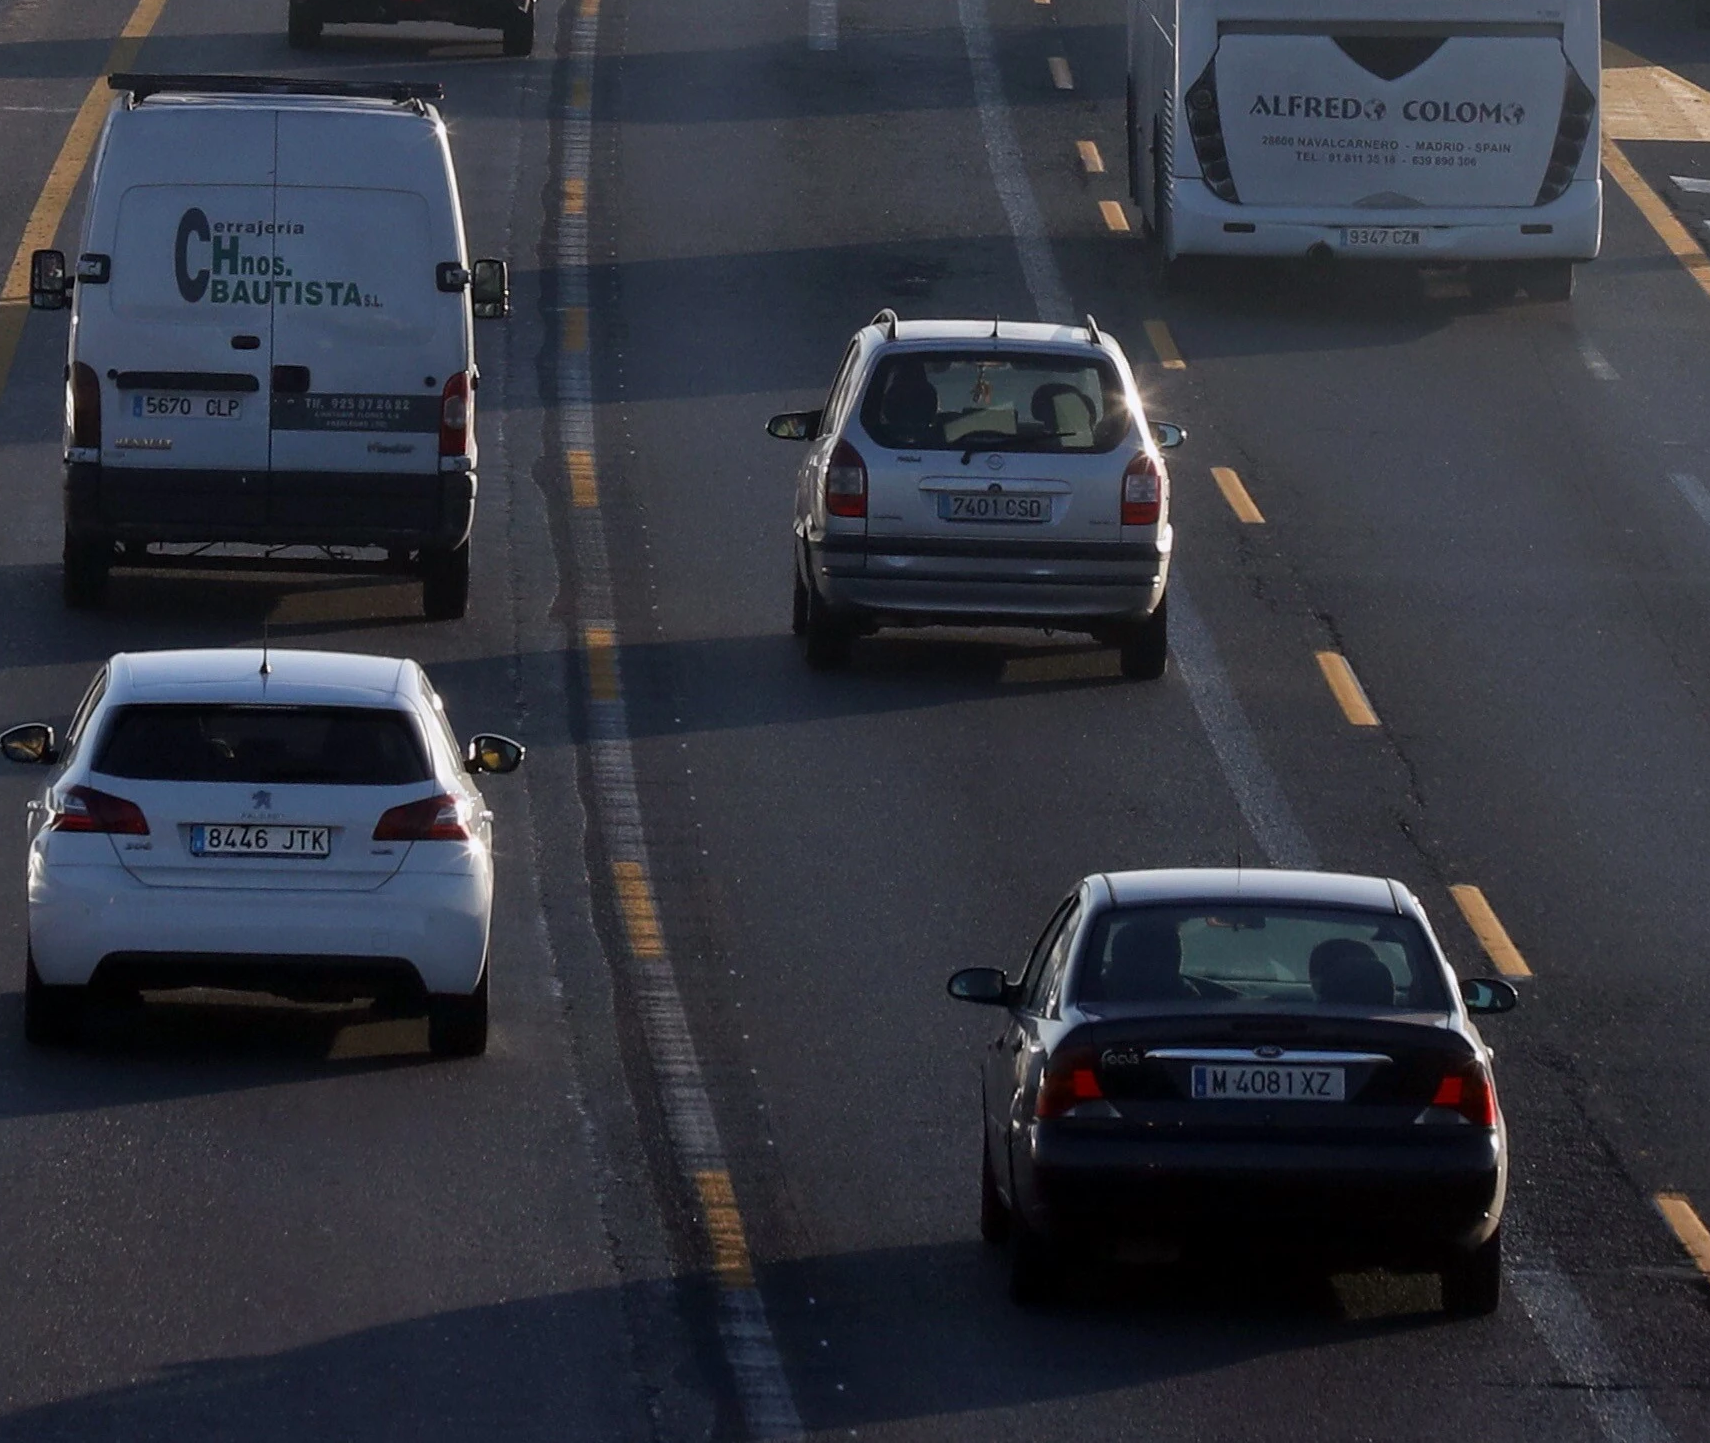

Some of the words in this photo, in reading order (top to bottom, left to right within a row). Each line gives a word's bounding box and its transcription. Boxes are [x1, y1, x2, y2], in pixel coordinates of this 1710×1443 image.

[1249, 94, 1387, 122] ALFREDO
[1402, 100, 1526, 125] COLOMO
[1297, 136, 1399, 151] NAVALCARNERO
[1415, 140, 1465, 153] MADRID
[1475, 142, 1512, 154] SPAIN
[1349, 229, 1389, 245] 9347
[212, 235, 293, 277] Hnos.
[210, 279, 362, 307] BAUTISTA
[146, 396, 192, 415] 5670
[205, 398, 240, 417] CLP
[952, 497, 1000, 517] 7401
[1008, 498, 1041, 518] CSD
[208, 828, 268, 850] 8446
[282, 830, 326, 852] JTK
[1212, 1072, 1228, 1095] M
[1235, 1070, 1294, 1095] 4081
[1302, 1071, 1332, 1096] XZ
